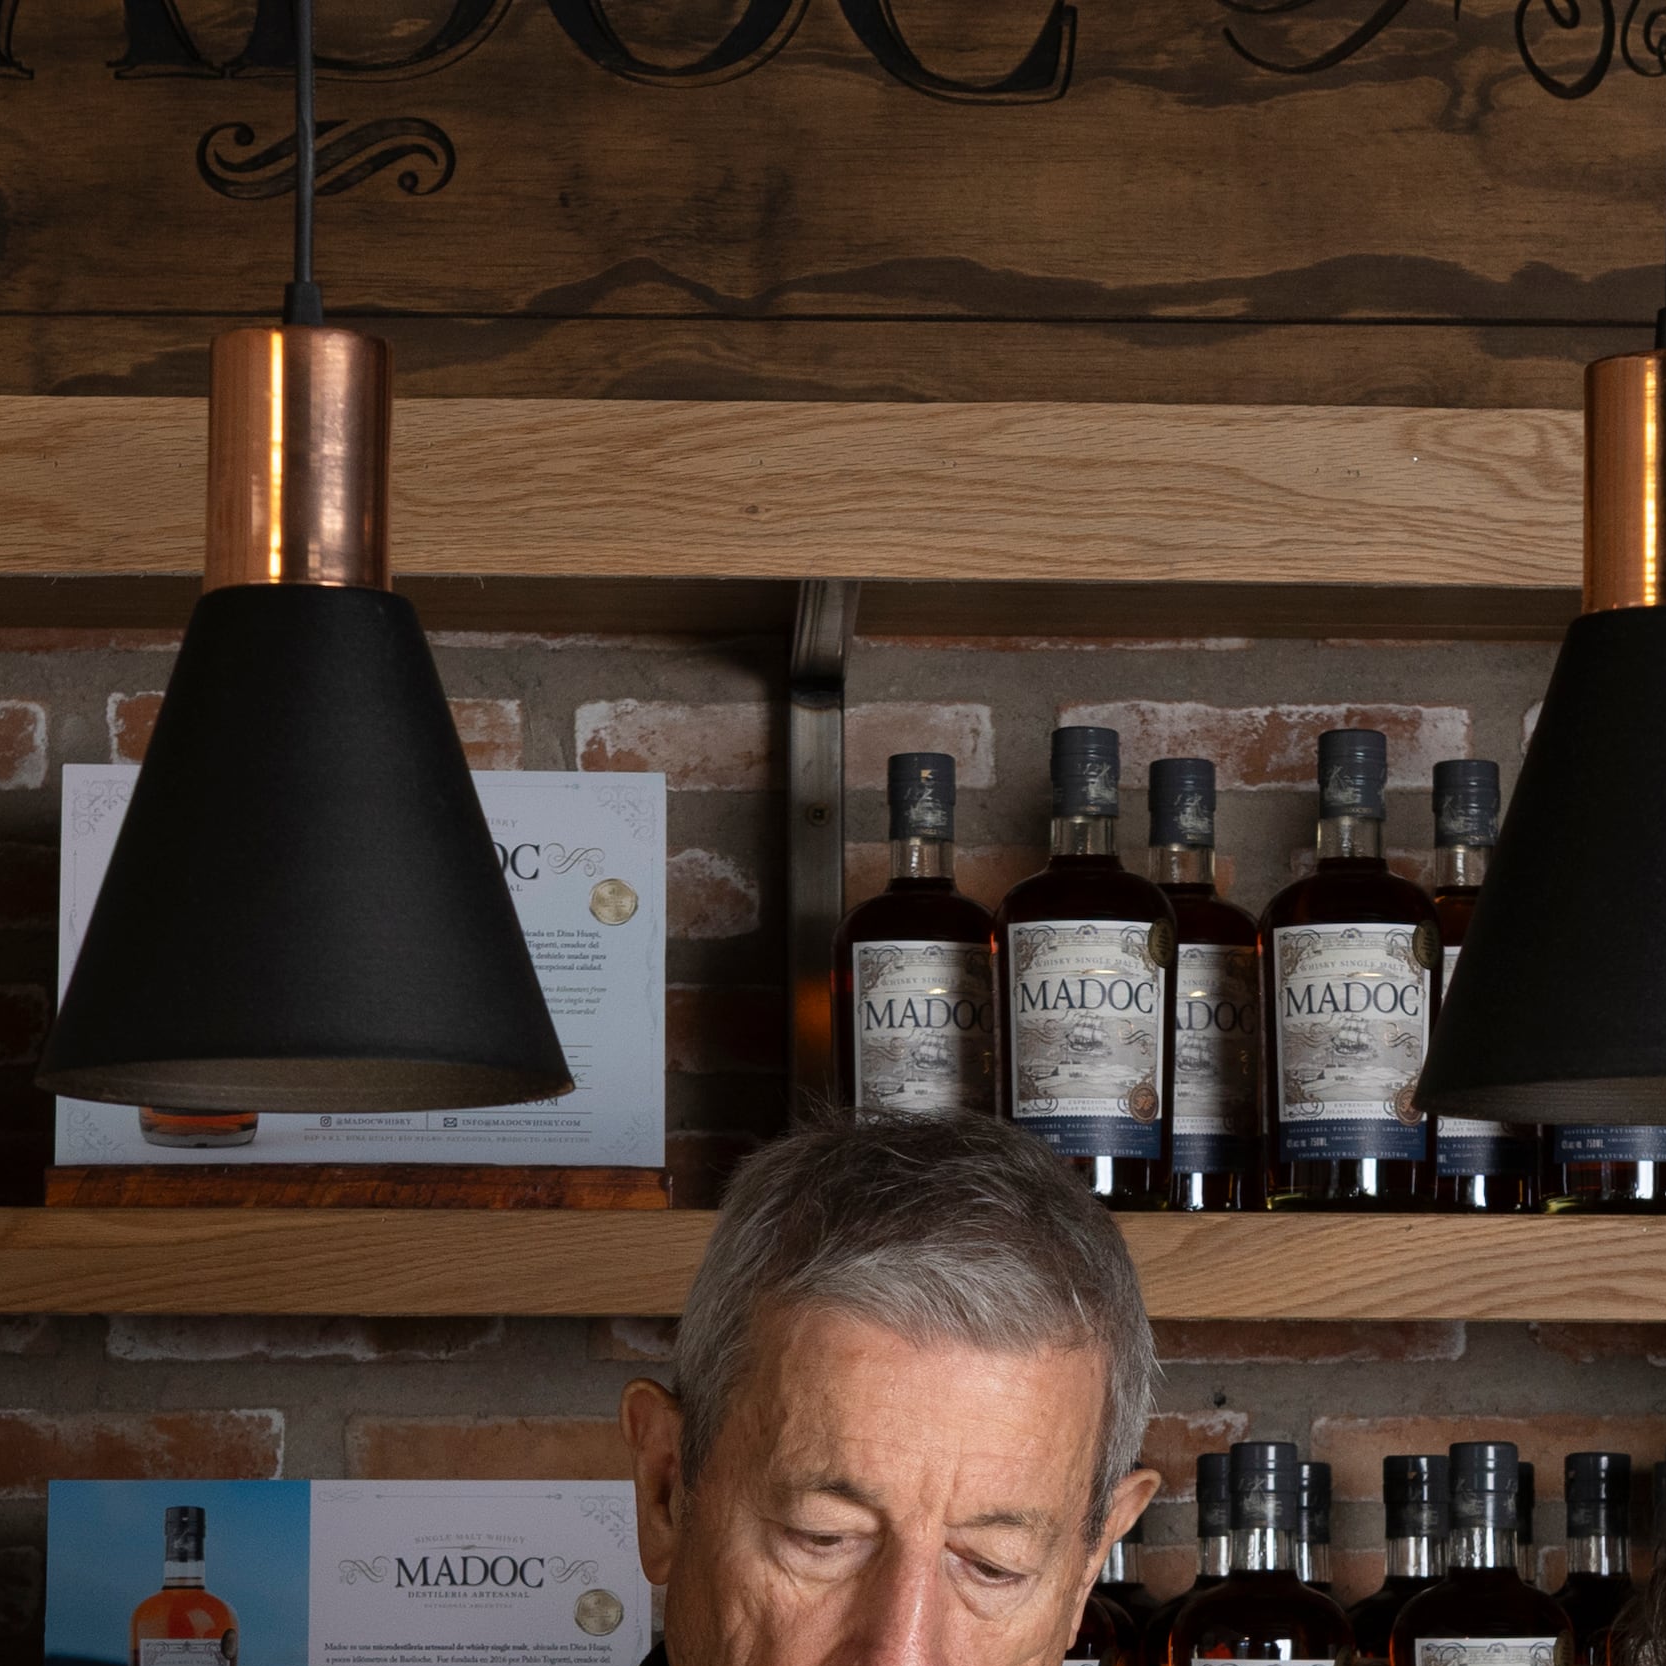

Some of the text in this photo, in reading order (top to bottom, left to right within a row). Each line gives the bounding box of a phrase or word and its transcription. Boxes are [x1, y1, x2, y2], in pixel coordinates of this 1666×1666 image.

[486, 819, 517, 827] ISKY
[1034, 957, 1070, 968] WHISKY
[1115, 959, 1140, 969] MALT
[1299, 962, 1335, 972] WHISKY
[1340, 960, 1378, 968] SINGLE
[1020, 979, 1154, 1014] MADOC
[1285, 982, 1419, 1017] MADOC
[865, 998, 994, 1033] MADOC
[1176, 1000, 1255, 1035] DOC
[455, 1533, 483, 1542] MALT
[395, 1555, 545, 1588] MADOC
[471, 1591, 530, 1599] ARTESANAL
